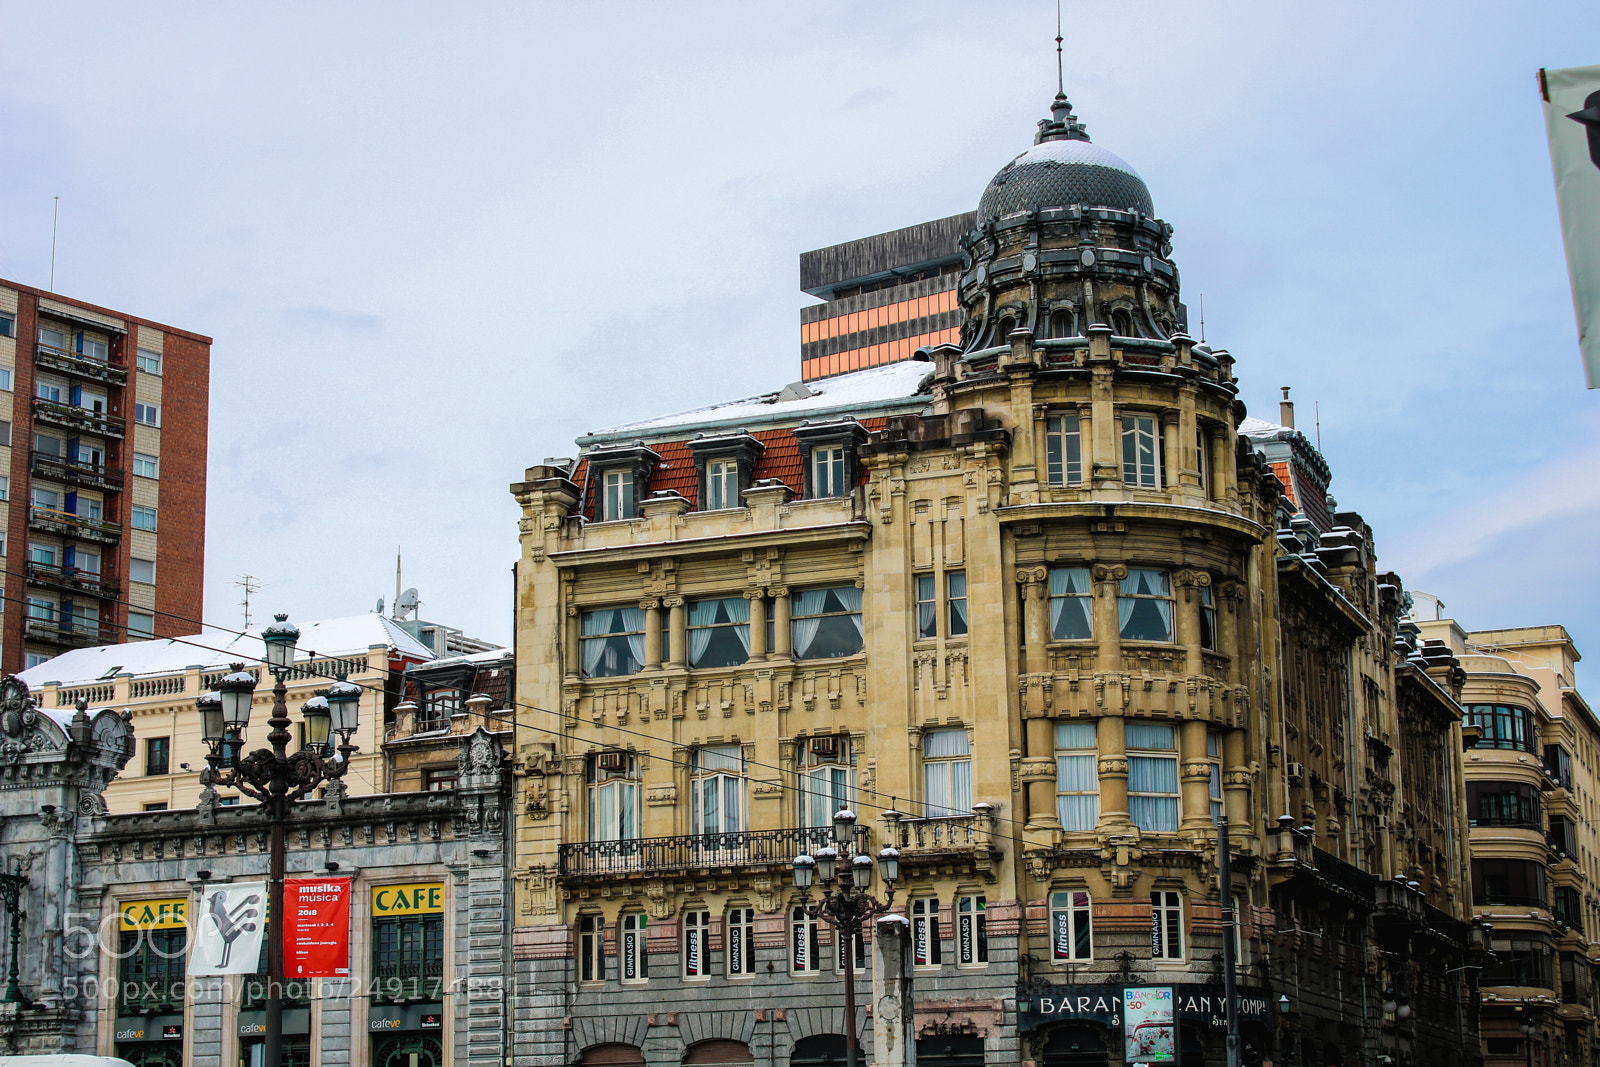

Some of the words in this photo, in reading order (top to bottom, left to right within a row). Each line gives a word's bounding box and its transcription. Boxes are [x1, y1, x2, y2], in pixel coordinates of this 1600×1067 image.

[298, 893, 338, 902] música
[299, 884, 341, 893] musika
[375, 887, 441, 911] CAFE
[124, 903, 185, 926] CAFE
[1151, 912, 1160, 955] GIMNASIO
[626, 935, 634, 976] GIMNASIO
[732, 929, 740, 971] GIMNASIO
